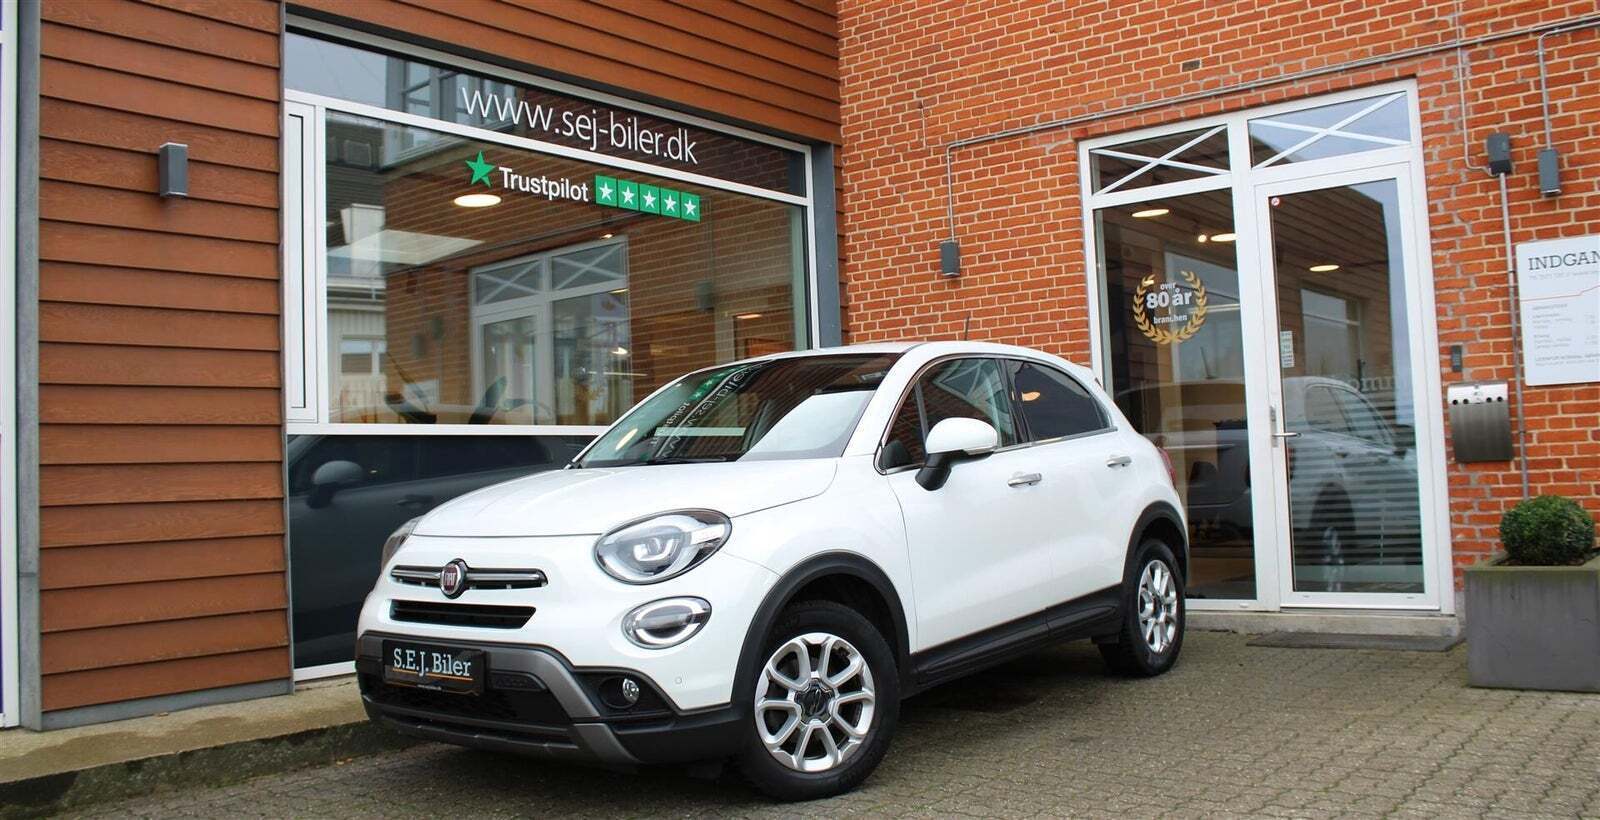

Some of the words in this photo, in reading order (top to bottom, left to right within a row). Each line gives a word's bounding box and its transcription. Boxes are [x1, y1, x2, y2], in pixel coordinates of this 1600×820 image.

[461, 86, 699, 165] www.sej-biler.dk
[498, 166, 589, 202] Trustpilot
[1146, 291, 1170, 309] 80
[1172, 288, 1192, 305] år
[1160, 281, 1176, 290] over
[393, 647, 429, 677] S.E.J.
[431, 652, 472, 677] Biler
